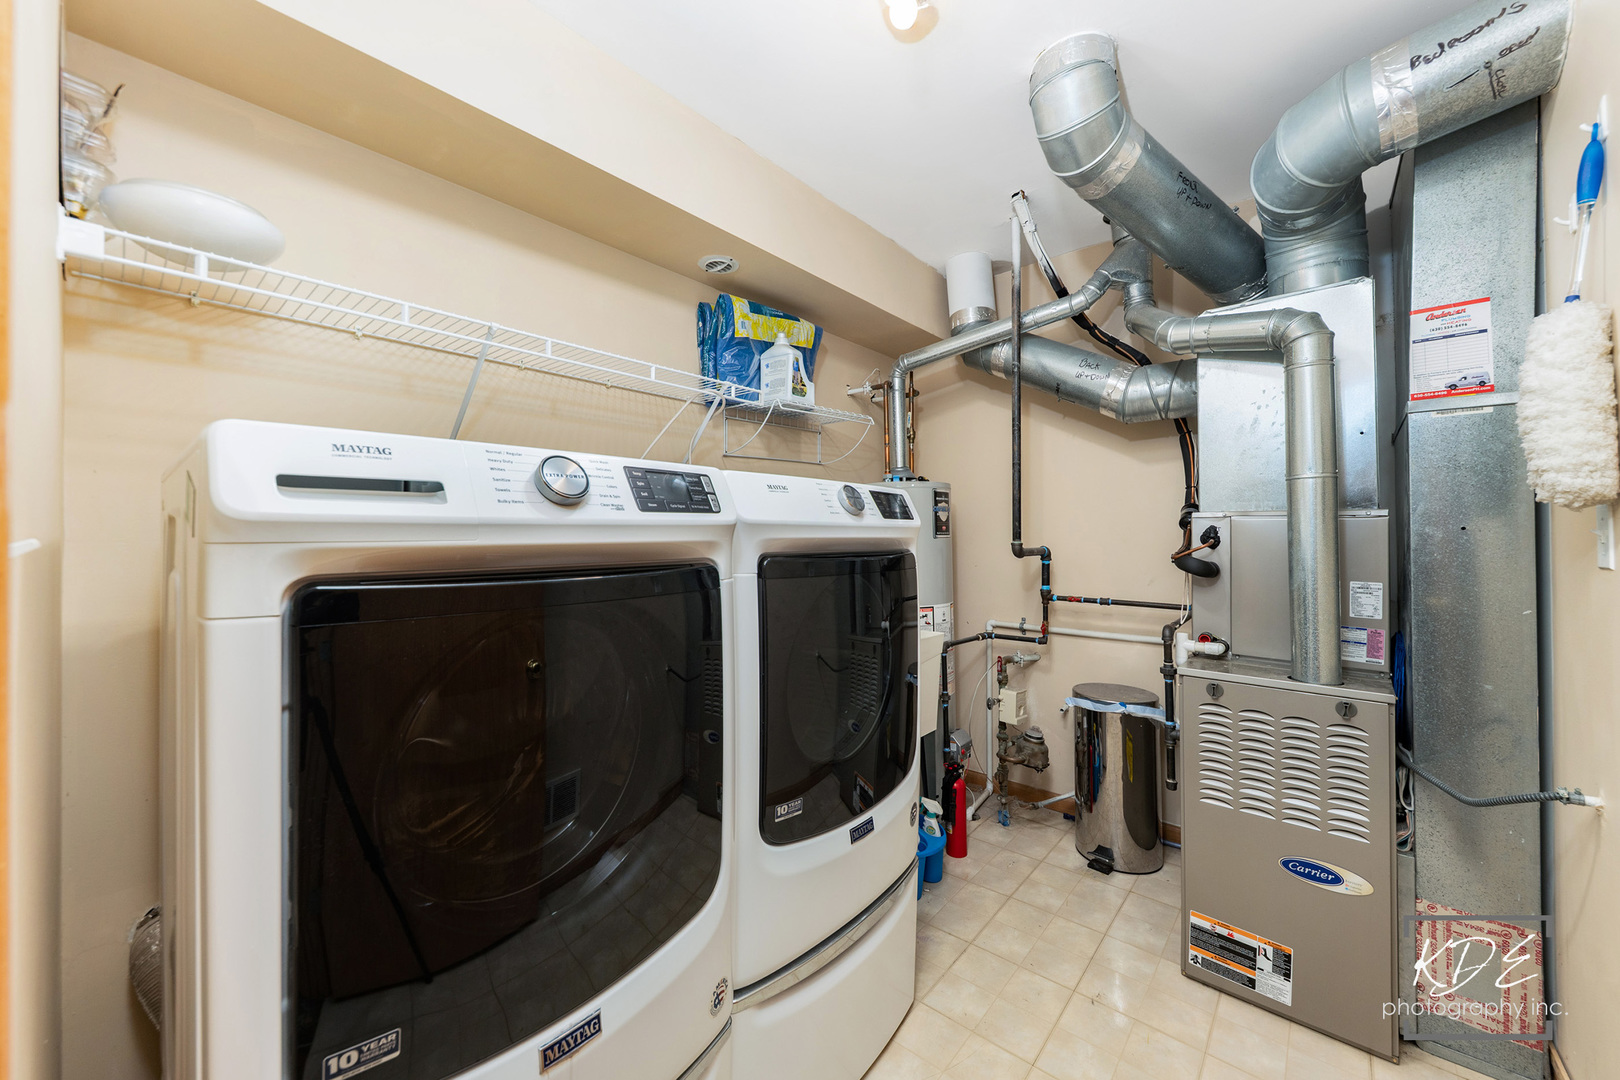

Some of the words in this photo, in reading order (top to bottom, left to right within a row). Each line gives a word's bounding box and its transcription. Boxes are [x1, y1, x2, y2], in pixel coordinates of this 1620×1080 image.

[332, 443, 392, 456] MAYTAG
[777, 804, 789, 817] 10
[1288, 861, 1336, 881] Carrier
[545, 1018, 600, 1065] MAYTAG
[327, 1049, 360, 1076] 10
[361, 1032, 398, 1053] YEAR
